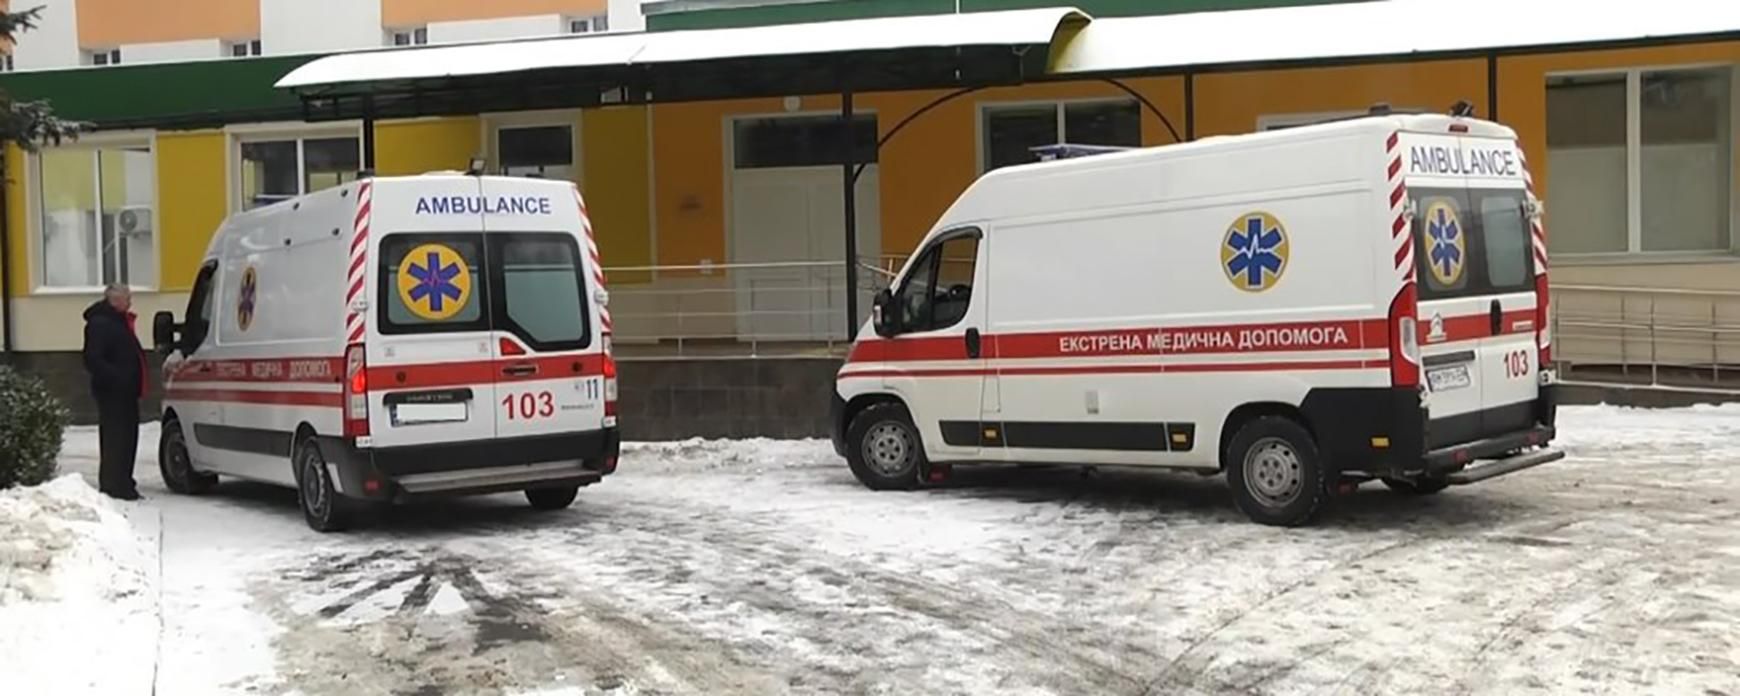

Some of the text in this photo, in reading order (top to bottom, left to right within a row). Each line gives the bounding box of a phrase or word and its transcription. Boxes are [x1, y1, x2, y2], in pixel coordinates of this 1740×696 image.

[1410, 146, 1516, 176] AMBULANCE
[415, 196, 552, 215] AMBULANCE
[1060, 327, 1348, 352] ЕКСТРЕНА МЕДИЧНА ДОПОМОГА
[1504, 349, 1529, 379] 103
[585, 378, 598, 399] 11
[502, 390, 555, 420] 103
